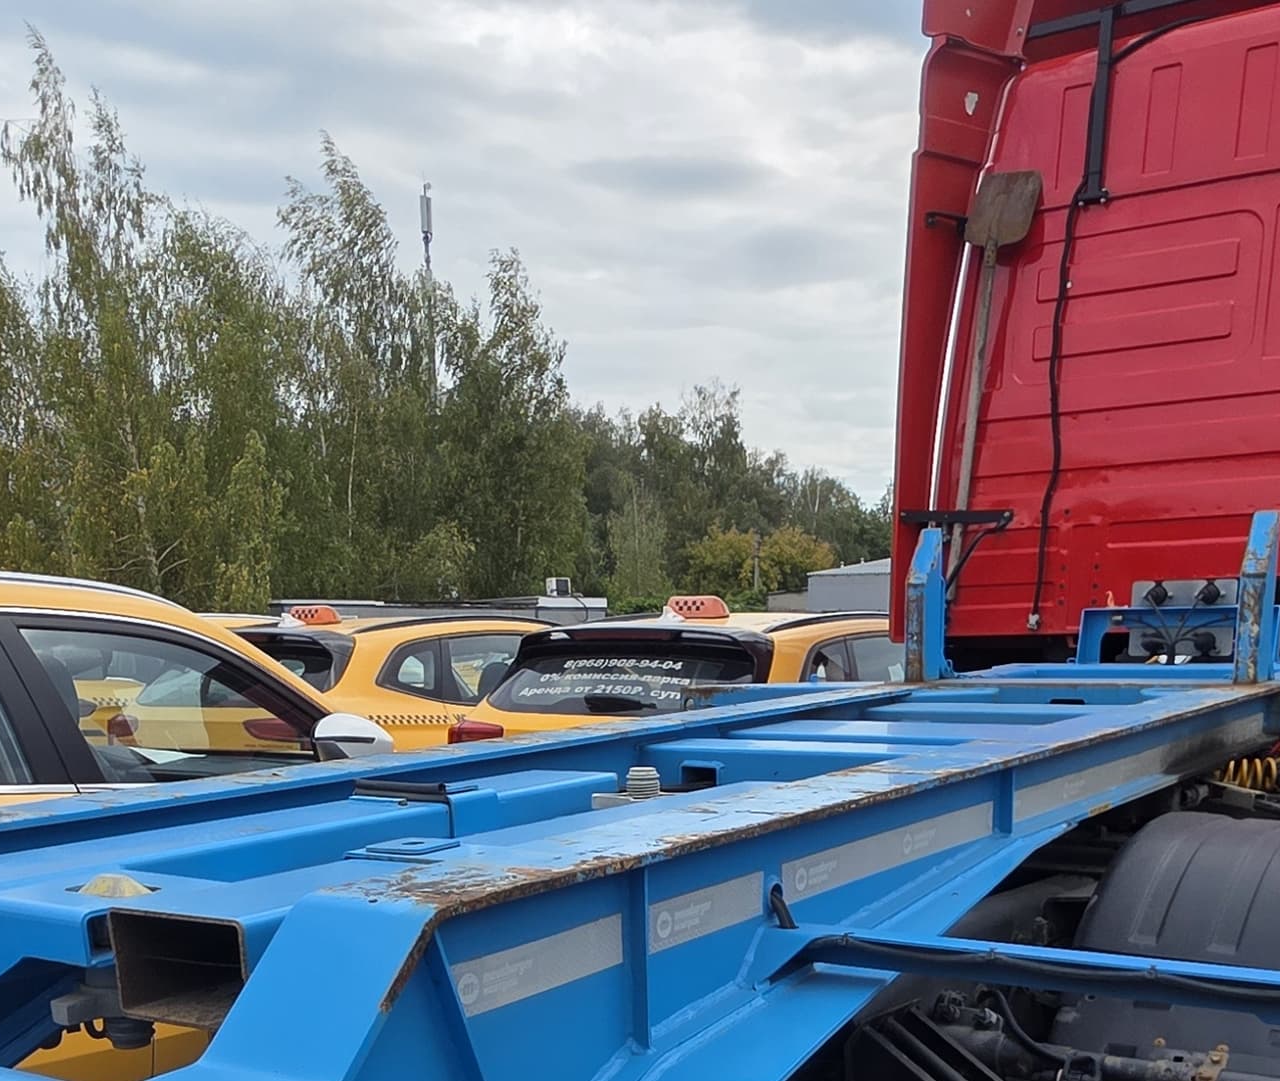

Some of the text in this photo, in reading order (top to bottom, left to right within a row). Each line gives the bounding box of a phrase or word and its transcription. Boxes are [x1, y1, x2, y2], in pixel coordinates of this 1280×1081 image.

[540, 673, 691, 686] 0% комиссия парка
[518, 686, 571, 697] Аренда
[574, 686, 593, 694] от
